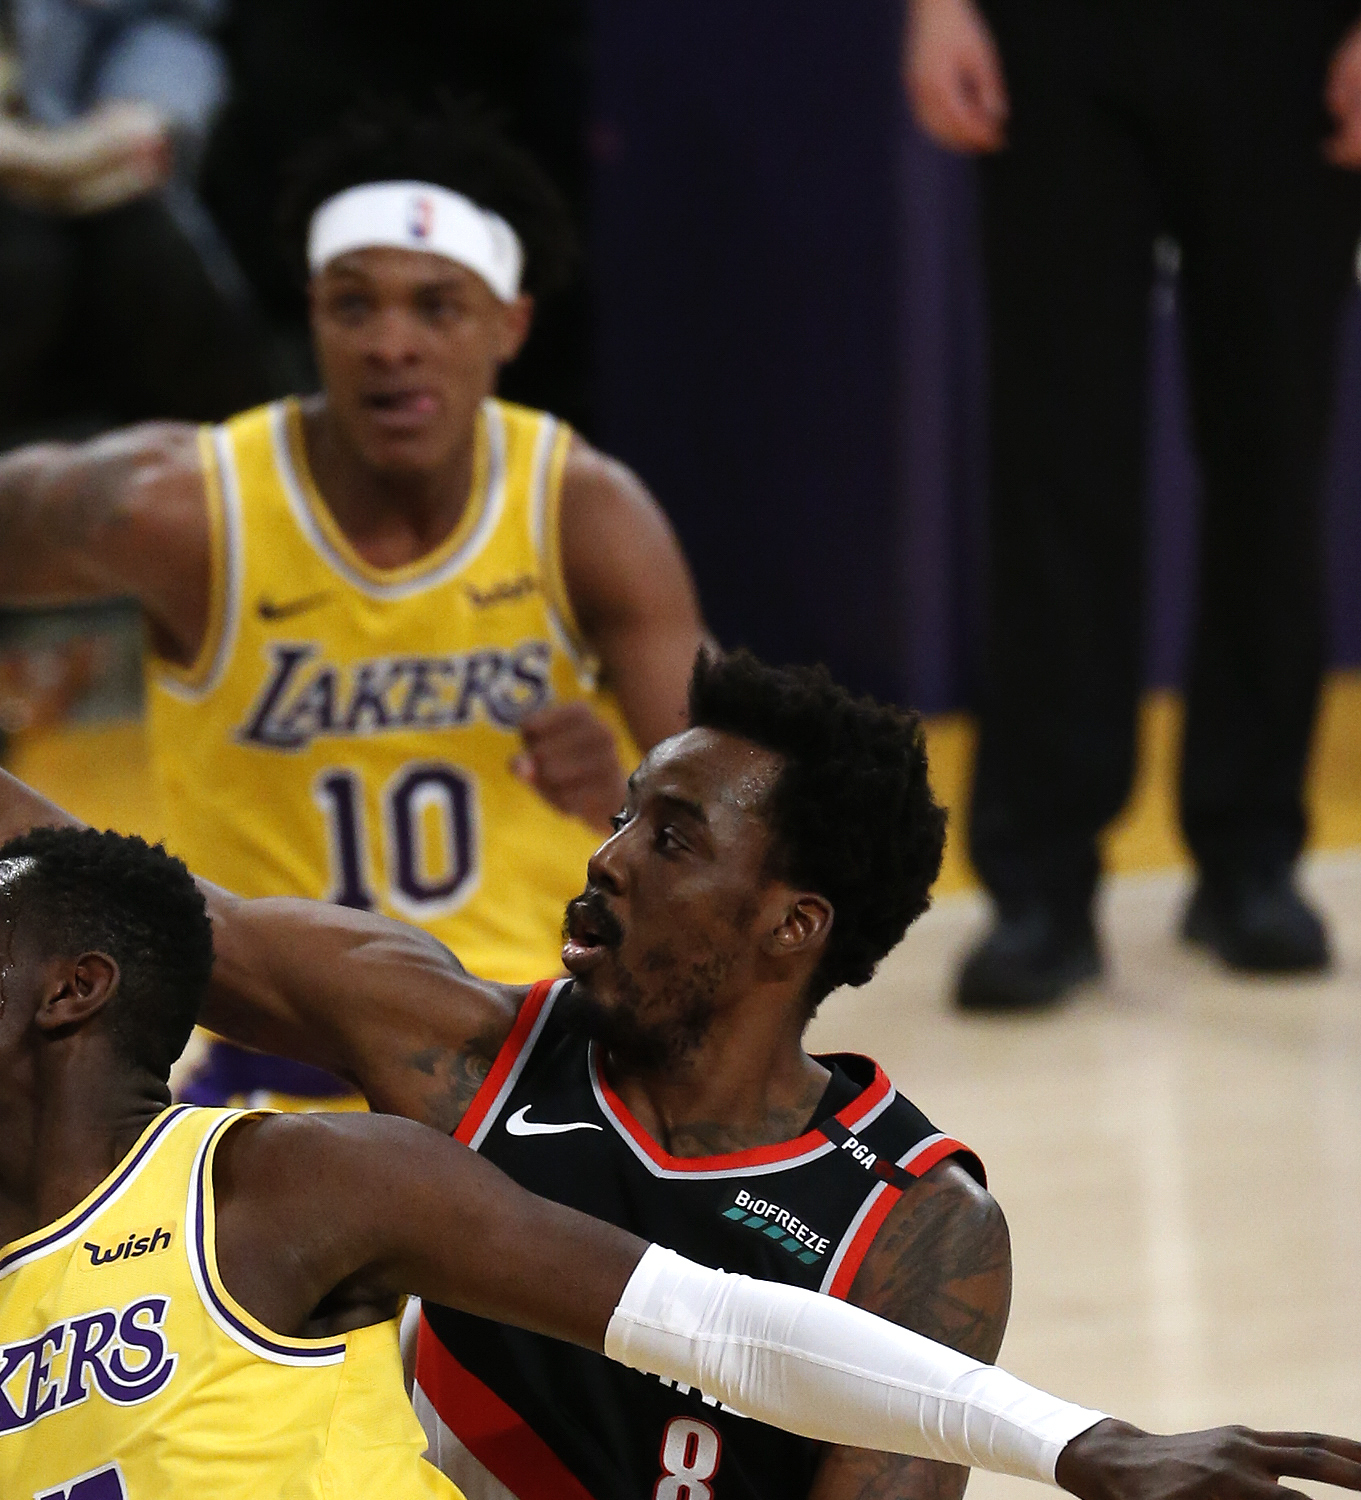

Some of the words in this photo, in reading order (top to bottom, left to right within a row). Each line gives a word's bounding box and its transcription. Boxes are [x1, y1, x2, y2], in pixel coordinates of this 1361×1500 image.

[234, 638, 554, 755] LAKERS
[312, 760, 483, 919] 10
[840, 1136, 878, 1171] PGA
[82, 1226, 173, 1268] wish
